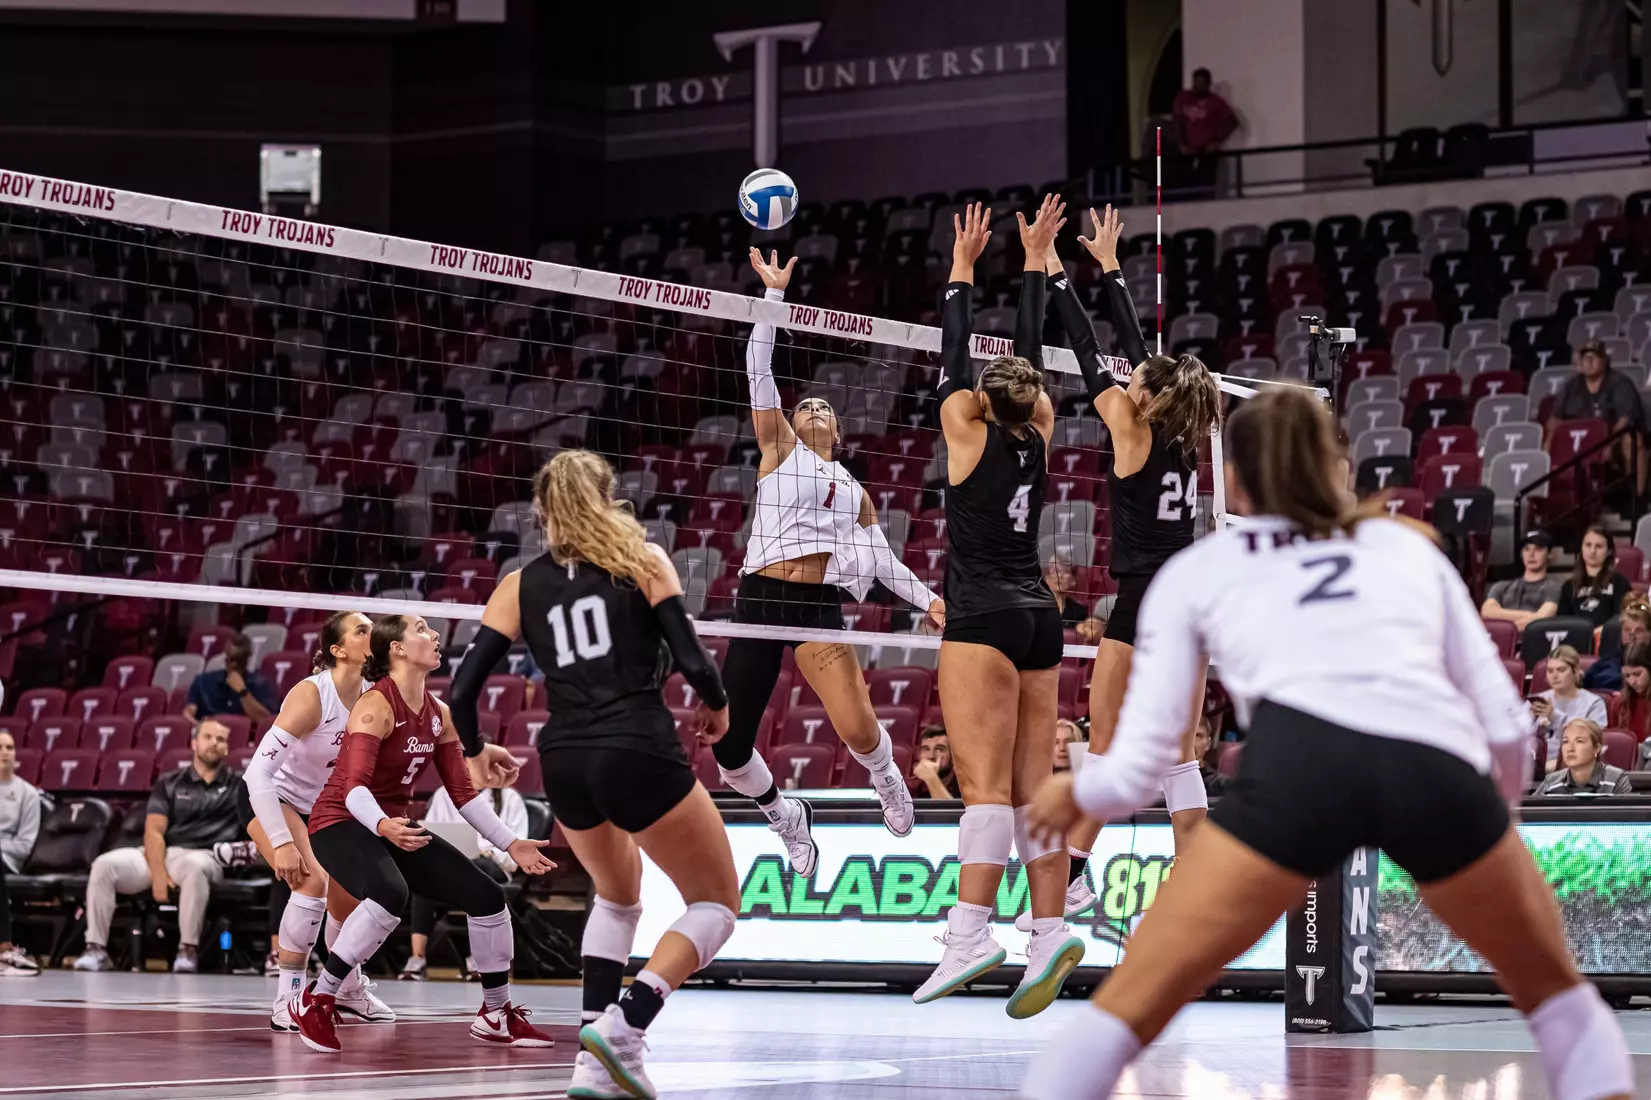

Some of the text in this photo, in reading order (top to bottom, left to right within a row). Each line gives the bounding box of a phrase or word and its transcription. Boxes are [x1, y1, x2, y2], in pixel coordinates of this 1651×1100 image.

[629, 74, 730, 110] TROY
[804, 39, 1062, 91] UNIVERSITY
[0, 172, 116, 212] ROY TROJANS
[221, 209, 336, 248] TROY TROJANS
[430, 244, 533, 281] TROY TROJANS
[618, 276, 712, 310] TROY TROJANS
[789, 304, 874, 336] TROY TROJANS
[974, 335, 1014, 357] TROJAN
[822, 481, 837, 510] 1
[1007, 484, 1033, 533] 4
[1156, 470, 1198, 521] 24
[1297, 554, 1357, 607] 2
[546, 594, 613, 669] 10
[400, 757, 426, 785] 5
